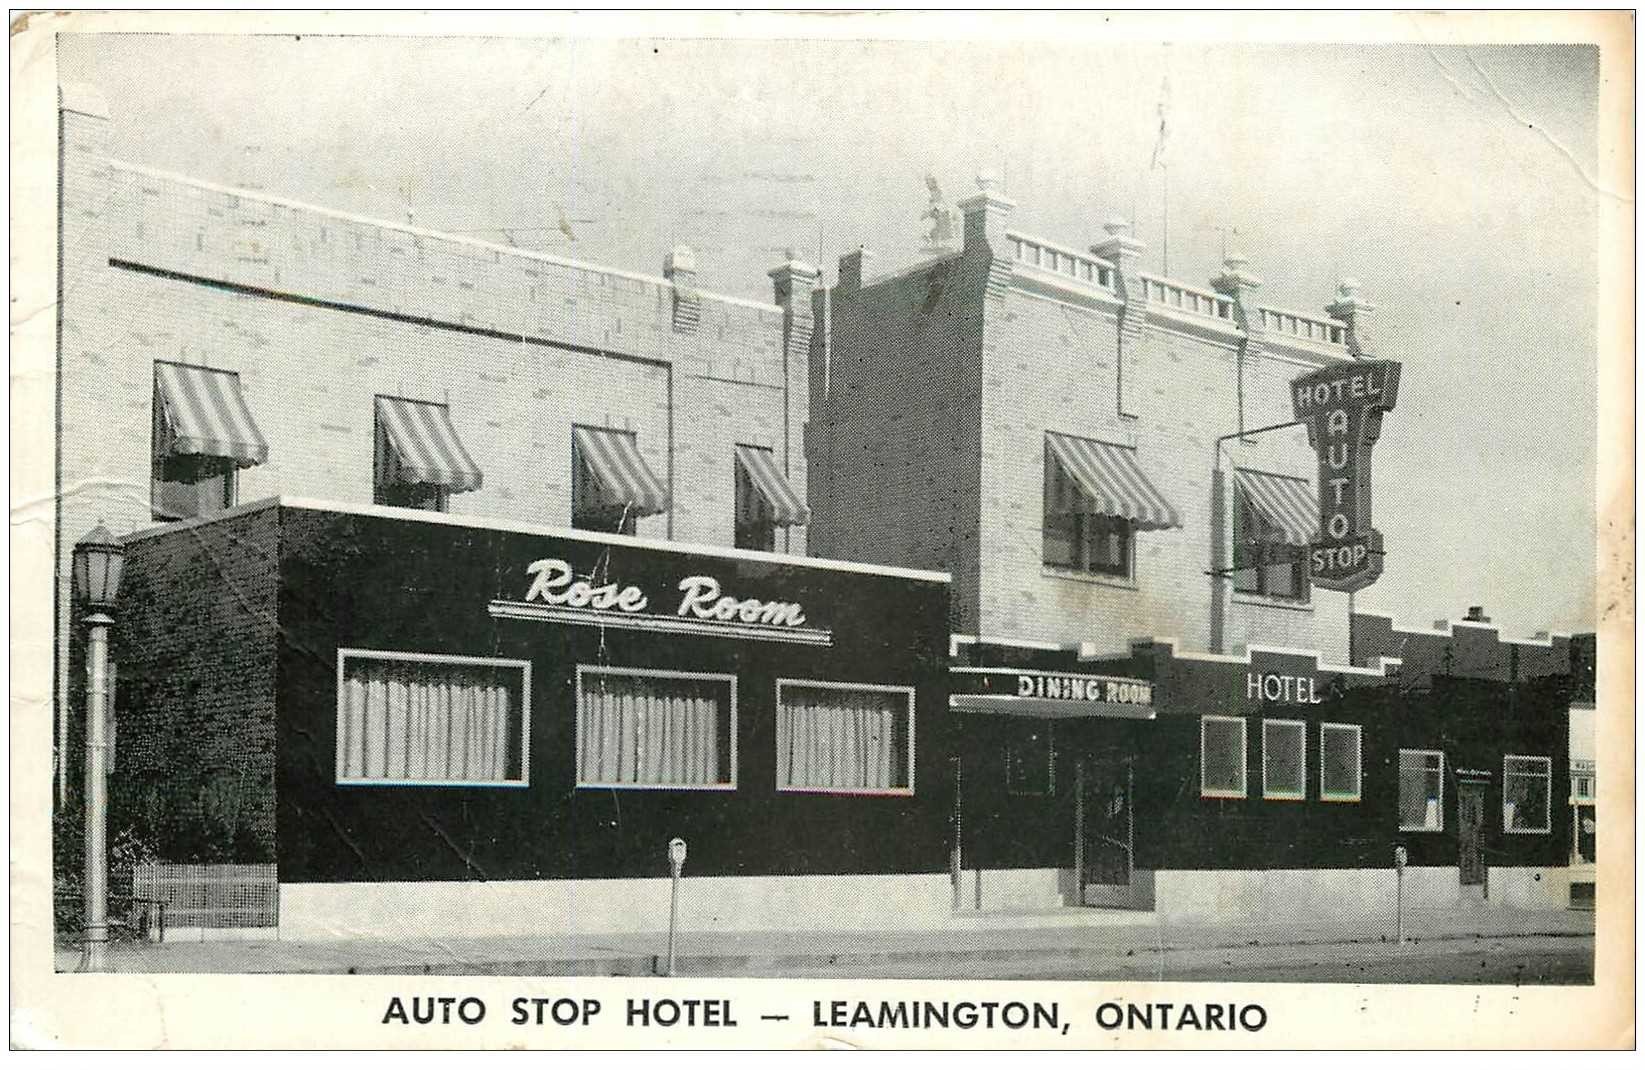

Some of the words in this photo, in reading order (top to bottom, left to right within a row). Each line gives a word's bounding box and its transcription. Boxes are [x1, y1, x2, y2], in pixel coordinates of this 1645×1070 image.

[1298, 373, 1382, 406] HOTEL
[1327, 409, 1350, 539] AUTO
[1312, 544, 1366, 572] STOP
[526, 558, 648, 611] Rose
[678, 575, 806, 626] Room
[1017, 674, 1101, 701] DINING
[1105, 681, 1152, 704] ROOM
[1246, 672, 1322, 704] HOTEL
